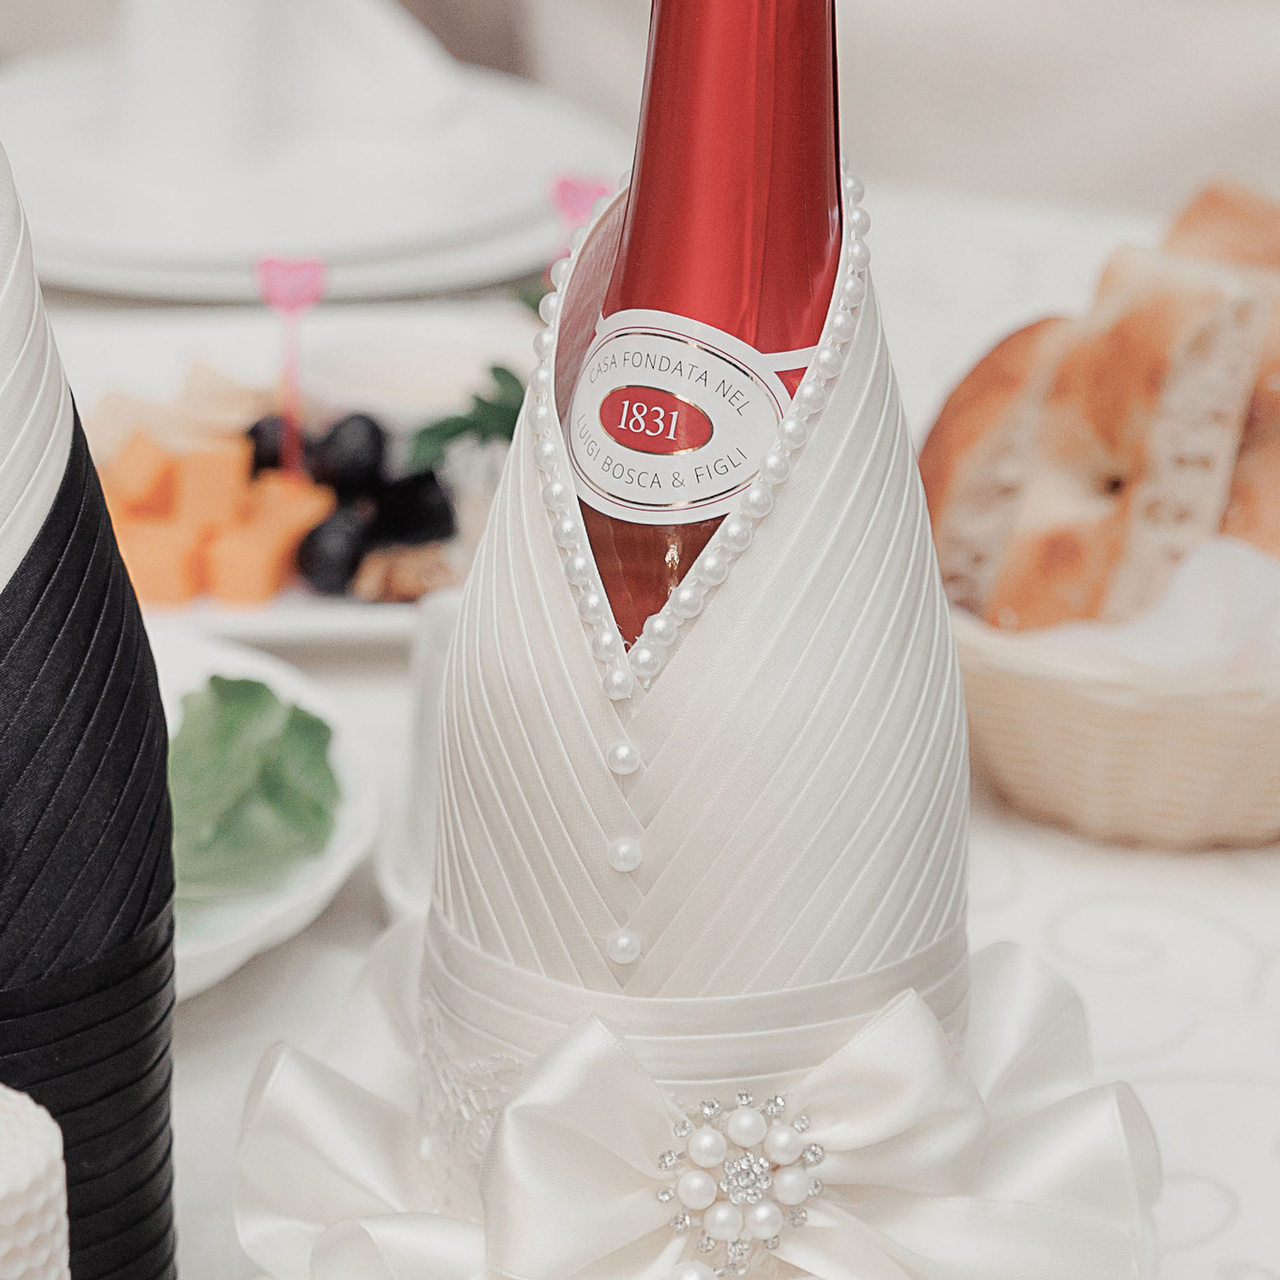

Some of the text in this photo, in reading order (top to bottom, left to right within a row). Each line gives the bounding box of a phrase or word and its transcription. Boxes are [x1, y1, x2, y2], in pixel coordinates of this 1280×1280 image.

[589, 351, 751, 416] CASA FONDATA NEL
[577, 413, 748, 489] LUIGI BOSCA & FIGLI
[617, 400, 680, 441] 1831
